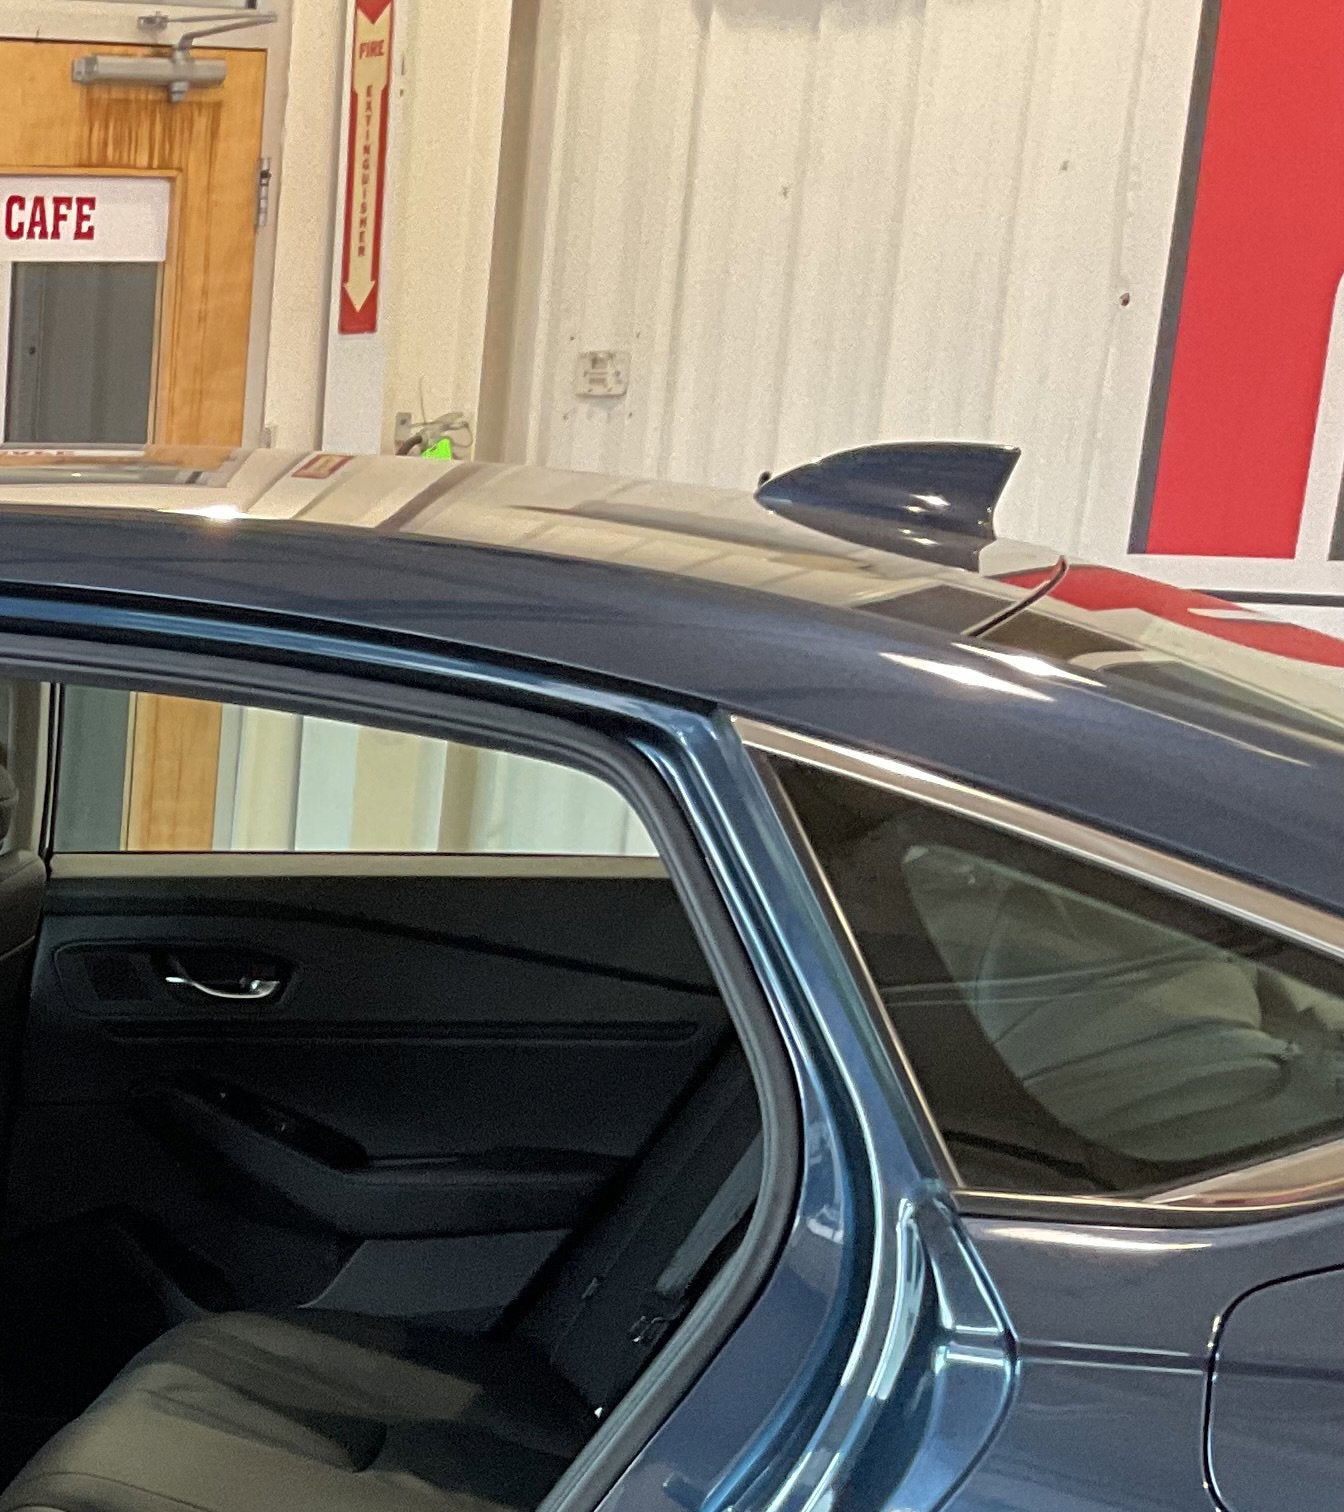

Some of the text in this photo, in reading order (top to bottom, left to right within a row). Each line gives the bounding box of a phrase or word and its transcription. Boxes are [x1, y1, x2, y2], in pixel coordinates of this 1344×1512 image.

[359, 40, 385, 59] FIRE
[357, 85, 374, 257] EXTINGUISHER
[4, 194, 96, 241] CAFE
